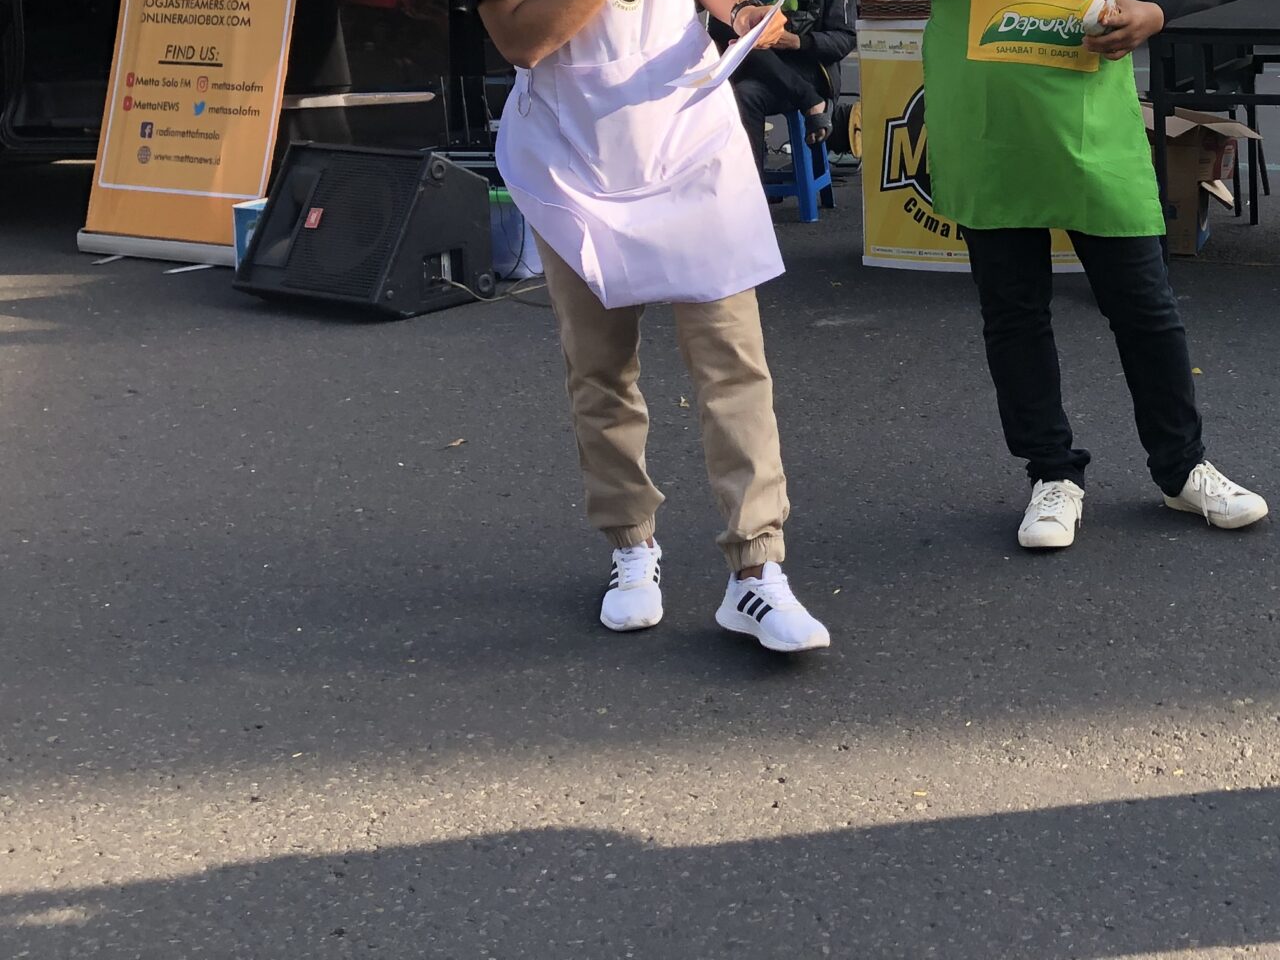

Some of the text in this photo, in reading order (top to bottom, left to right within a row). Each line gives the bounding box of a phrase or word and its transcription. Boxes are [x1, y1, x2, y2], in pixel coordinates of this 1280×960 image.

[141, 12, 251, 27] ONLINERADIOBOX.COM
[165, 44, 220, 61] FIND US:
[996, 46, 1079, 59] SAHABAT DI DAPUR
[135, 77, 191, 88] Metta Solo FM
[133, 100, 180, 112] MettaNEWS
[903, 197, 951, 238] Cuma
